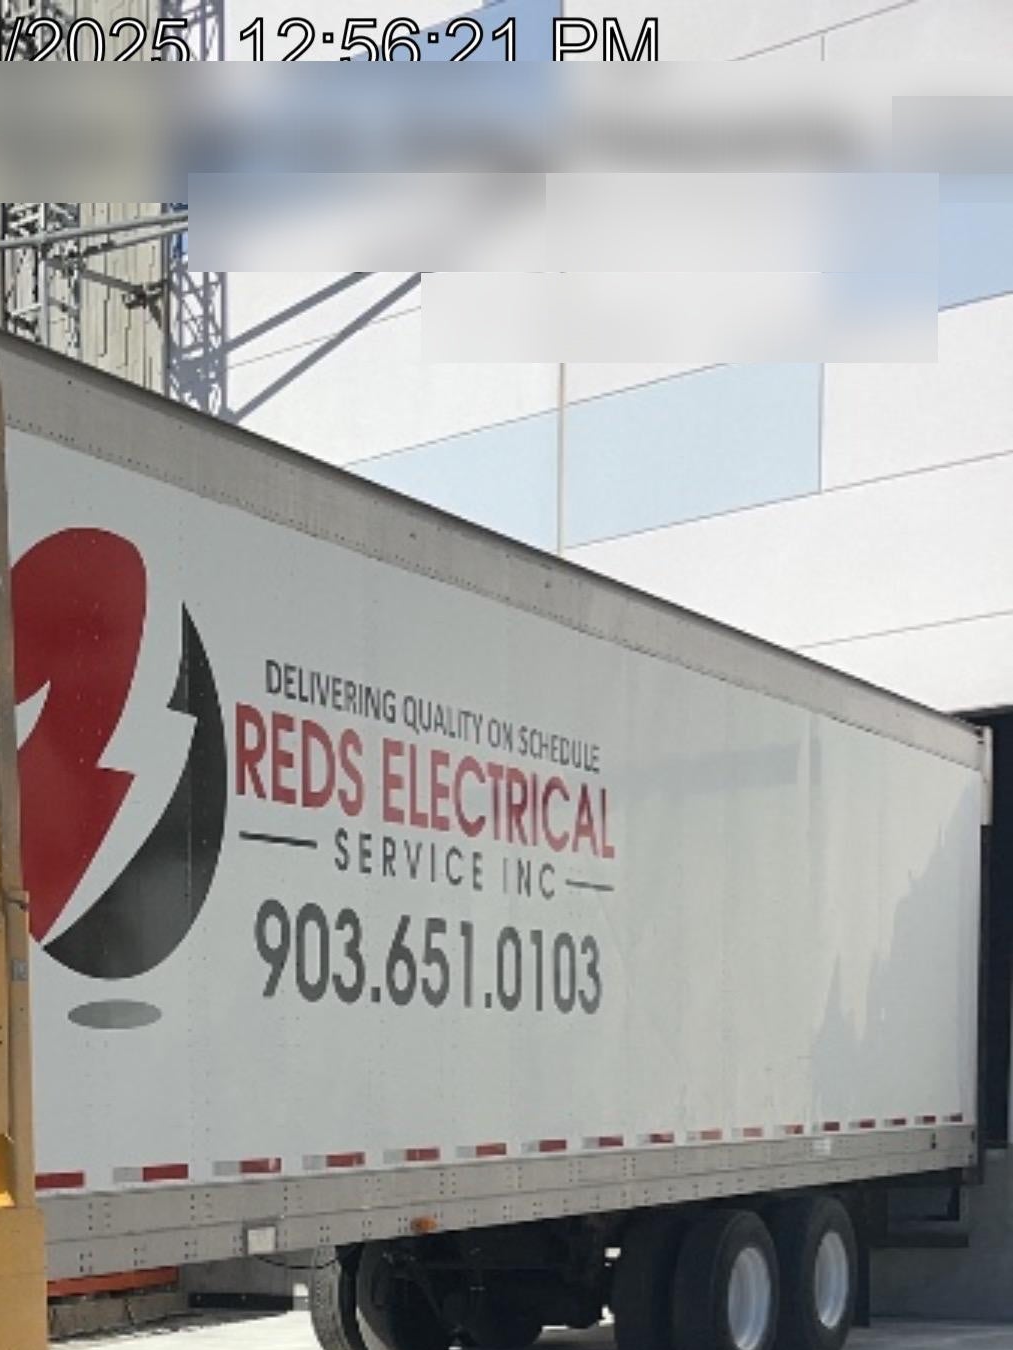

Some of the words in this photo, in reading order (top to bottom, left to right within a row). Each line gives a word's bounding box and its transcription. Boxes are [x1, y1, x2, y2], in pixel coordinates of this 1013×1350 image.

[265, 659, 396, 724] DELIVERING
[403, 694, 484, 745] QUALITY
[488, 717, 513, 750] ON
[517, 724, 601, 775] SCHEDULE
[235, 701, 364, 817] REDS
[382, 736, 616, 859] ELECTRICAL
[334, 827, 483, 891] SERVICE
[502, 858, 555, 900] INC
[255, 898, 603, 1015] 903.651.0103
